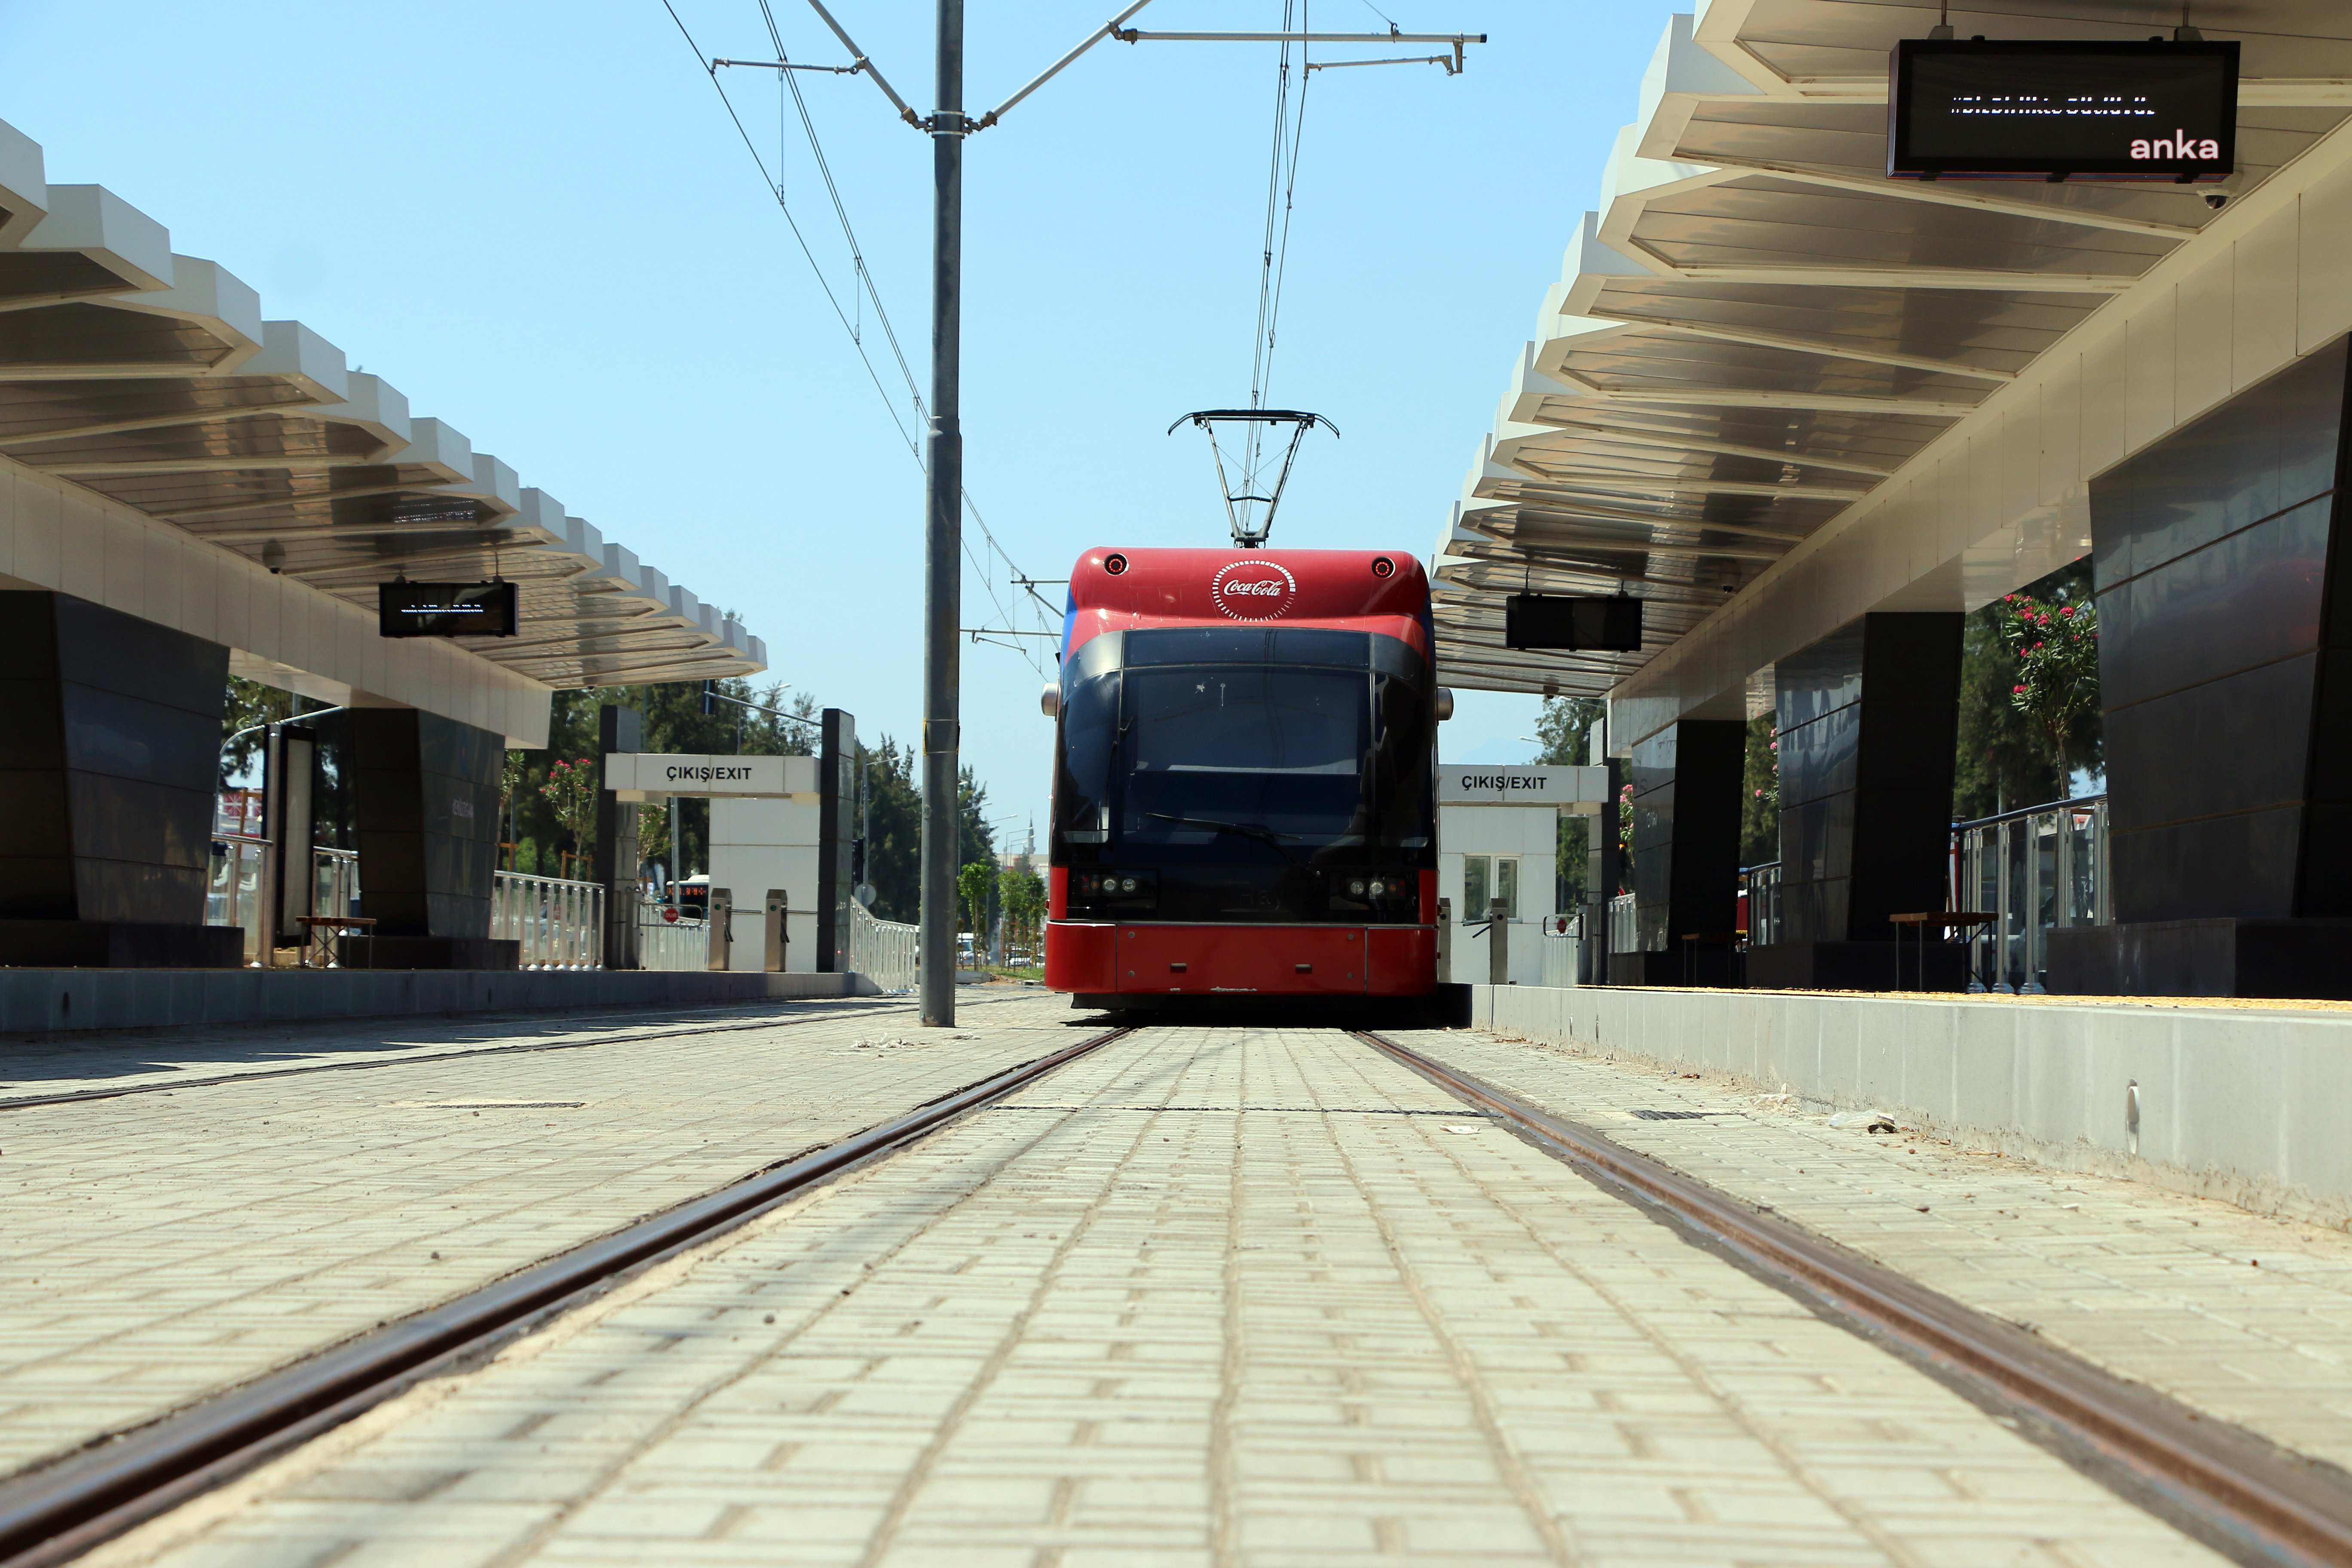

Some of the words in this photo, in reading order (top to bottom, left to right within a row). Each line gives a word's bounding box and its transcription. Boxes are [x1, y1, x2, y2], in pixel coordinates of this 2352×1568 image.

[2130, 128, 2219, 159] anka
[1223, 579, 1284, 596] Coca-Cola
[666, 766, 752, 782] ÇIKIŞ/EXIT
[1461, 775, 1547, 791] ÇIKIŞ/EXIT
